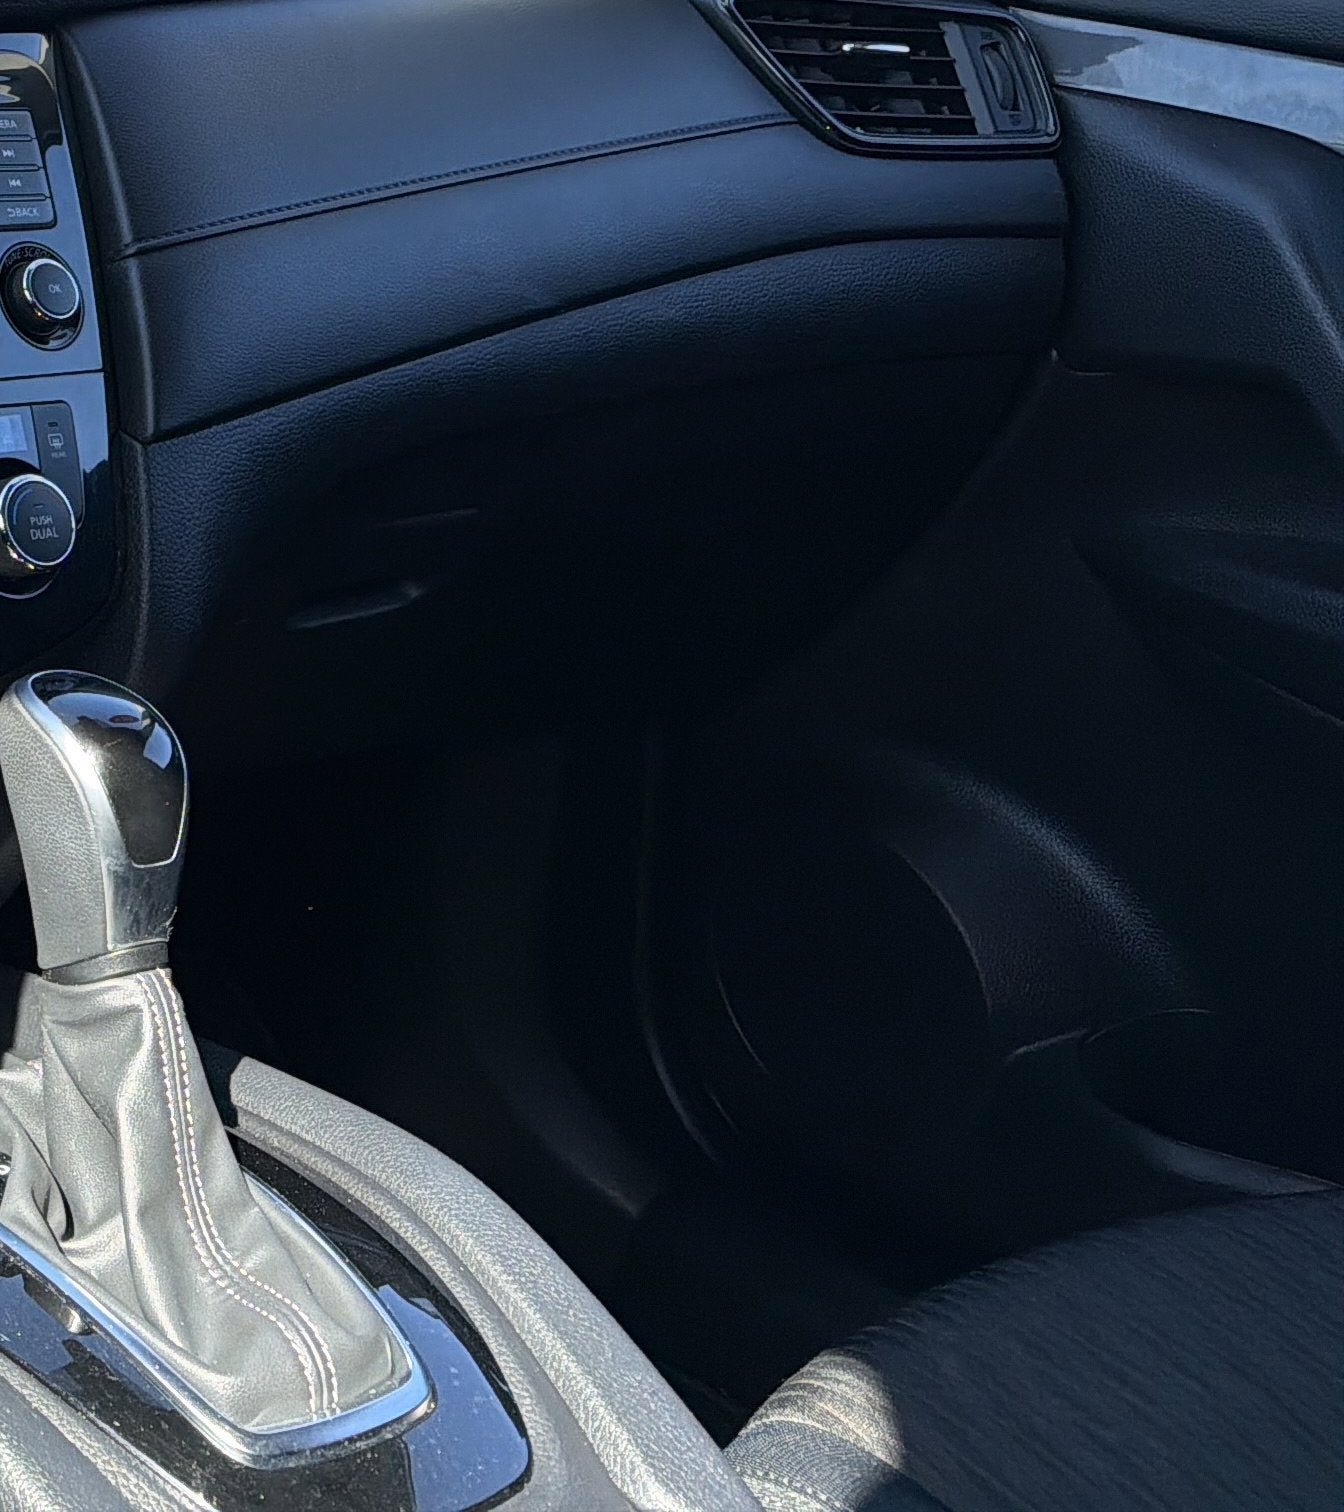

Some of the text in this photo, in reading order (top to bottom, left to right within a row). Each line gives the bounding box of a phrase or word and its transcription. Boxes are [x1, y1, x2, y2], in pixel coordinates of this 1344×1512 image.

[15, 206, 40, 218] BACK
[47, 282, 62, 294] OK
[29, 514, 53, 527] PUSH
[29, 526, 60, 541] DUAL
